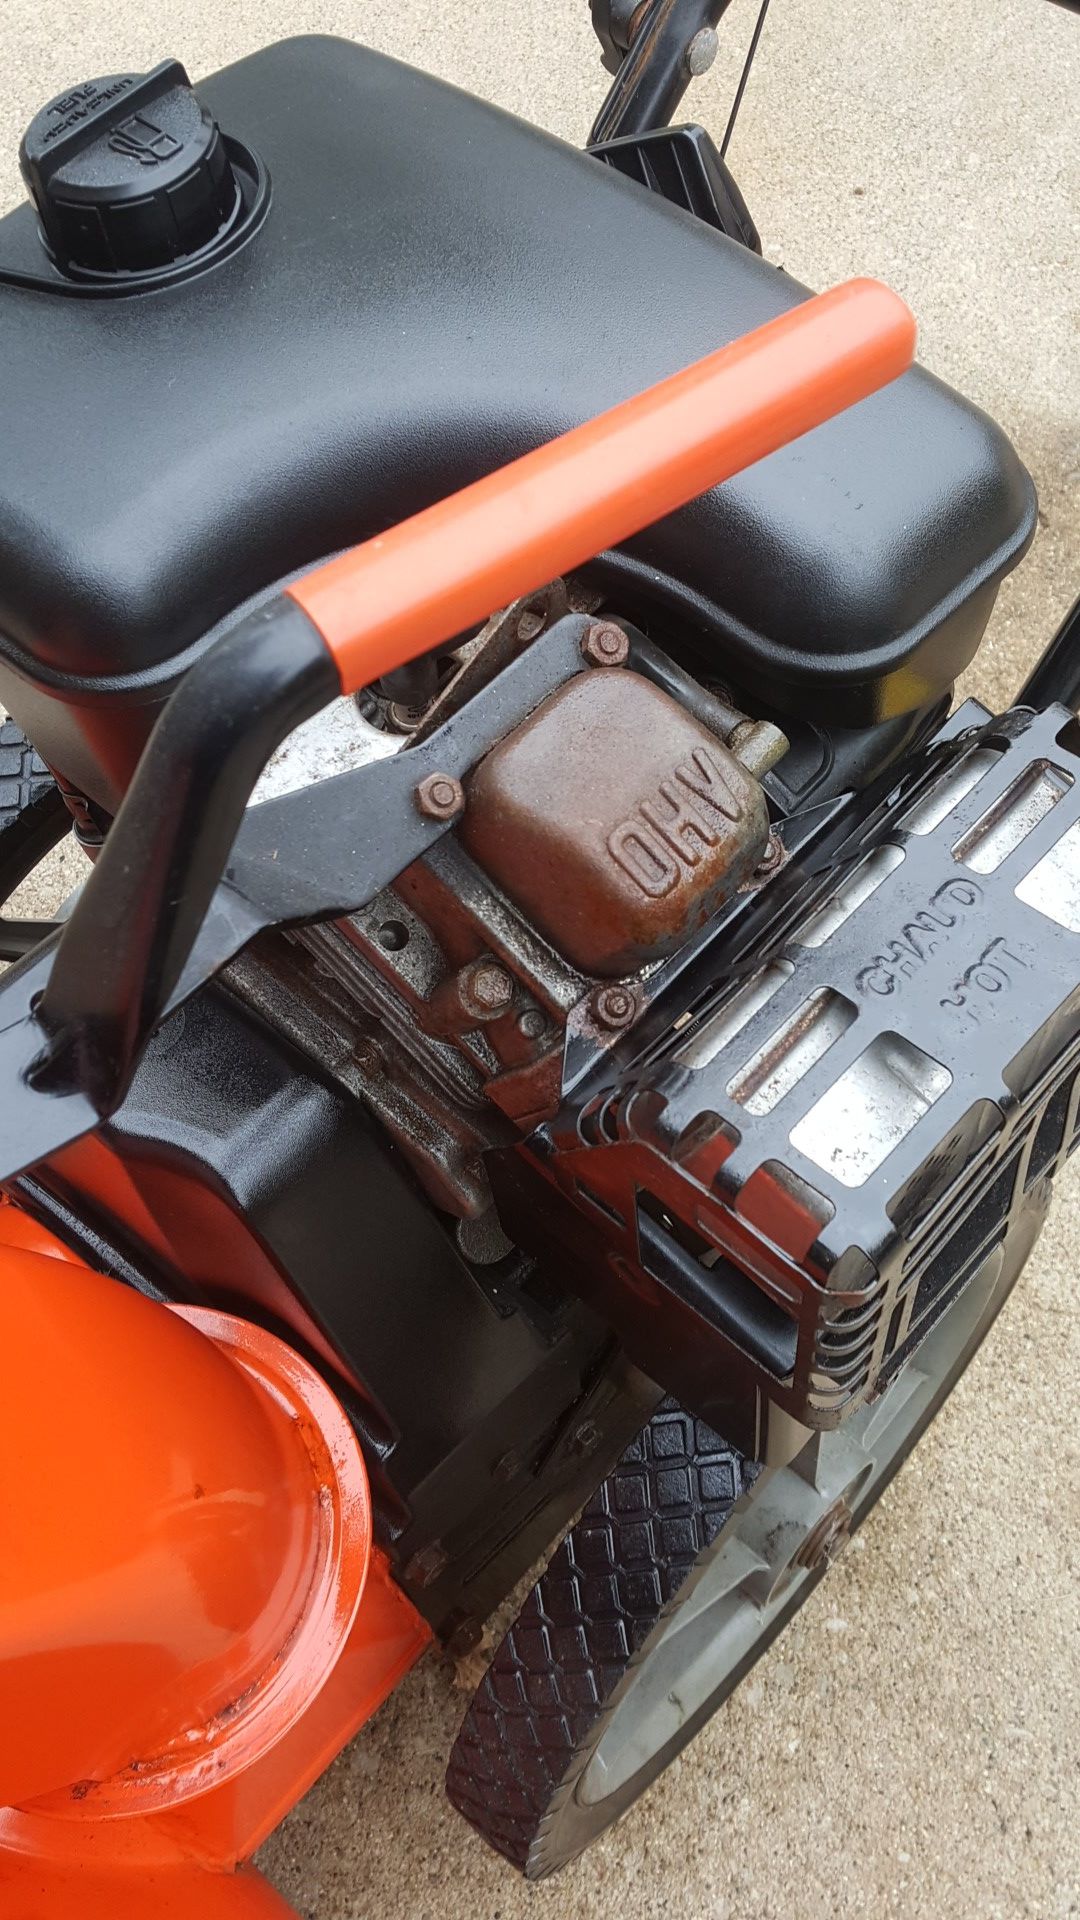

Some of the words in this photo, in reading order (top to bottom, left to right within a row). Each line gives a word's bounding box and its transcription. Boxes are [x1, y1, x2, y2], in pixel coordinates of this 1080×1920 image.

[42, 78, 133, 143] UNLEADED
[46, 84, 97, 116] FUEL
[606, 747, 744, 898] OHV
[938, 936, 1030, 1026] HOT
